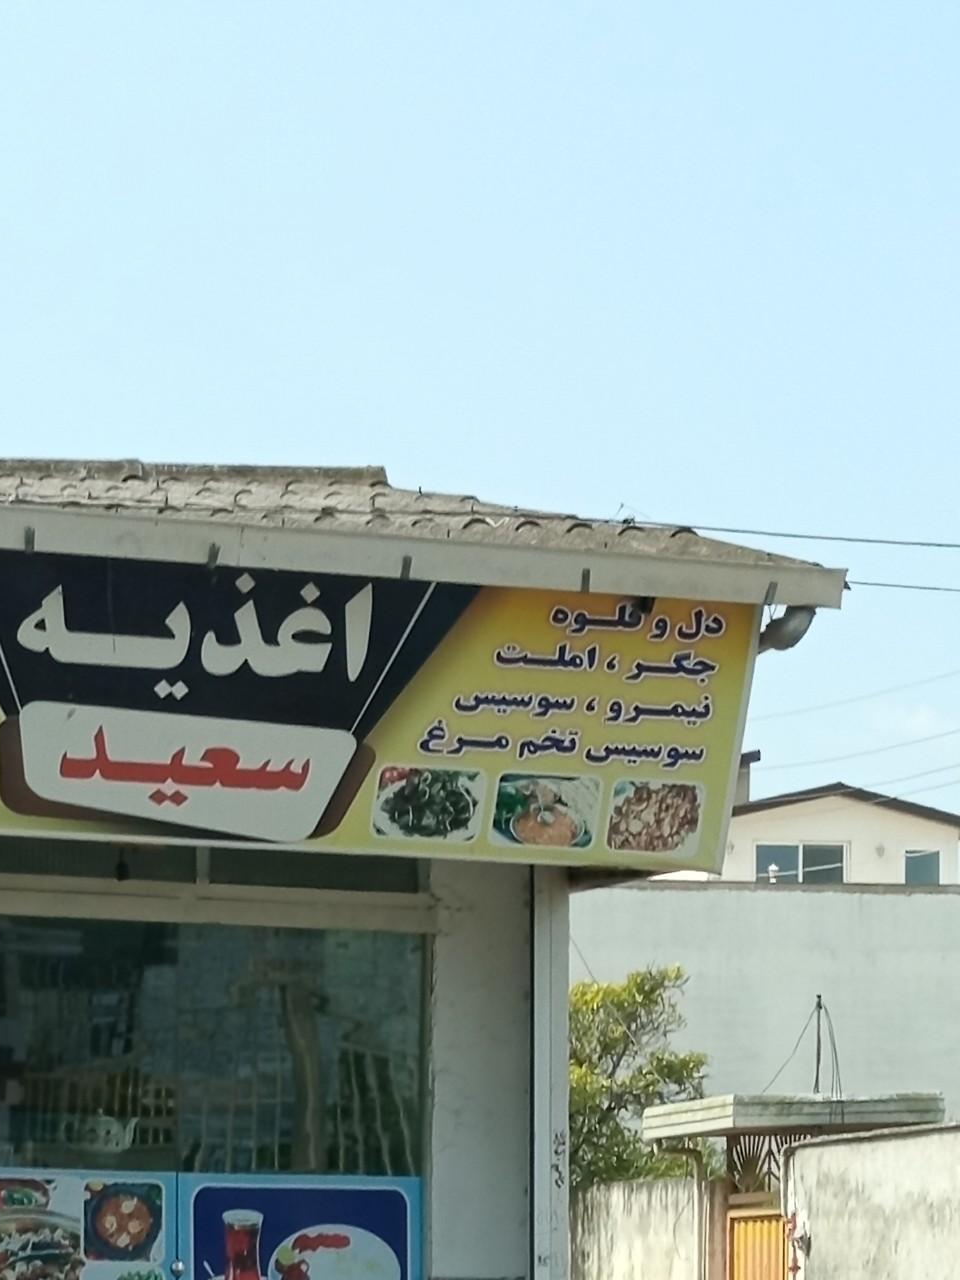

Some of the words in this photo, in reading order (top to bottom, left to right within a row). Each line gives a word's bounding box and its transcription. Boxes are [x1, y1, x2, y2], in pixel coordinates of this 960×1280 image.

[16, 573, 373, 700] اغذیه
[647, 615, 670, 641] و
[675, 606, 726, 642] دل
[495, 642, 598, 672] املت
[454, 692, 576, 717] سوسیس
[604, 694, 713, 726] نیمرو
[419, 718, 511, 755] مرغ
[518, 727, 581, 760] تخم
[58, 724, 311, 807] سعید
[585, 741, 706, 768] سوسیس
